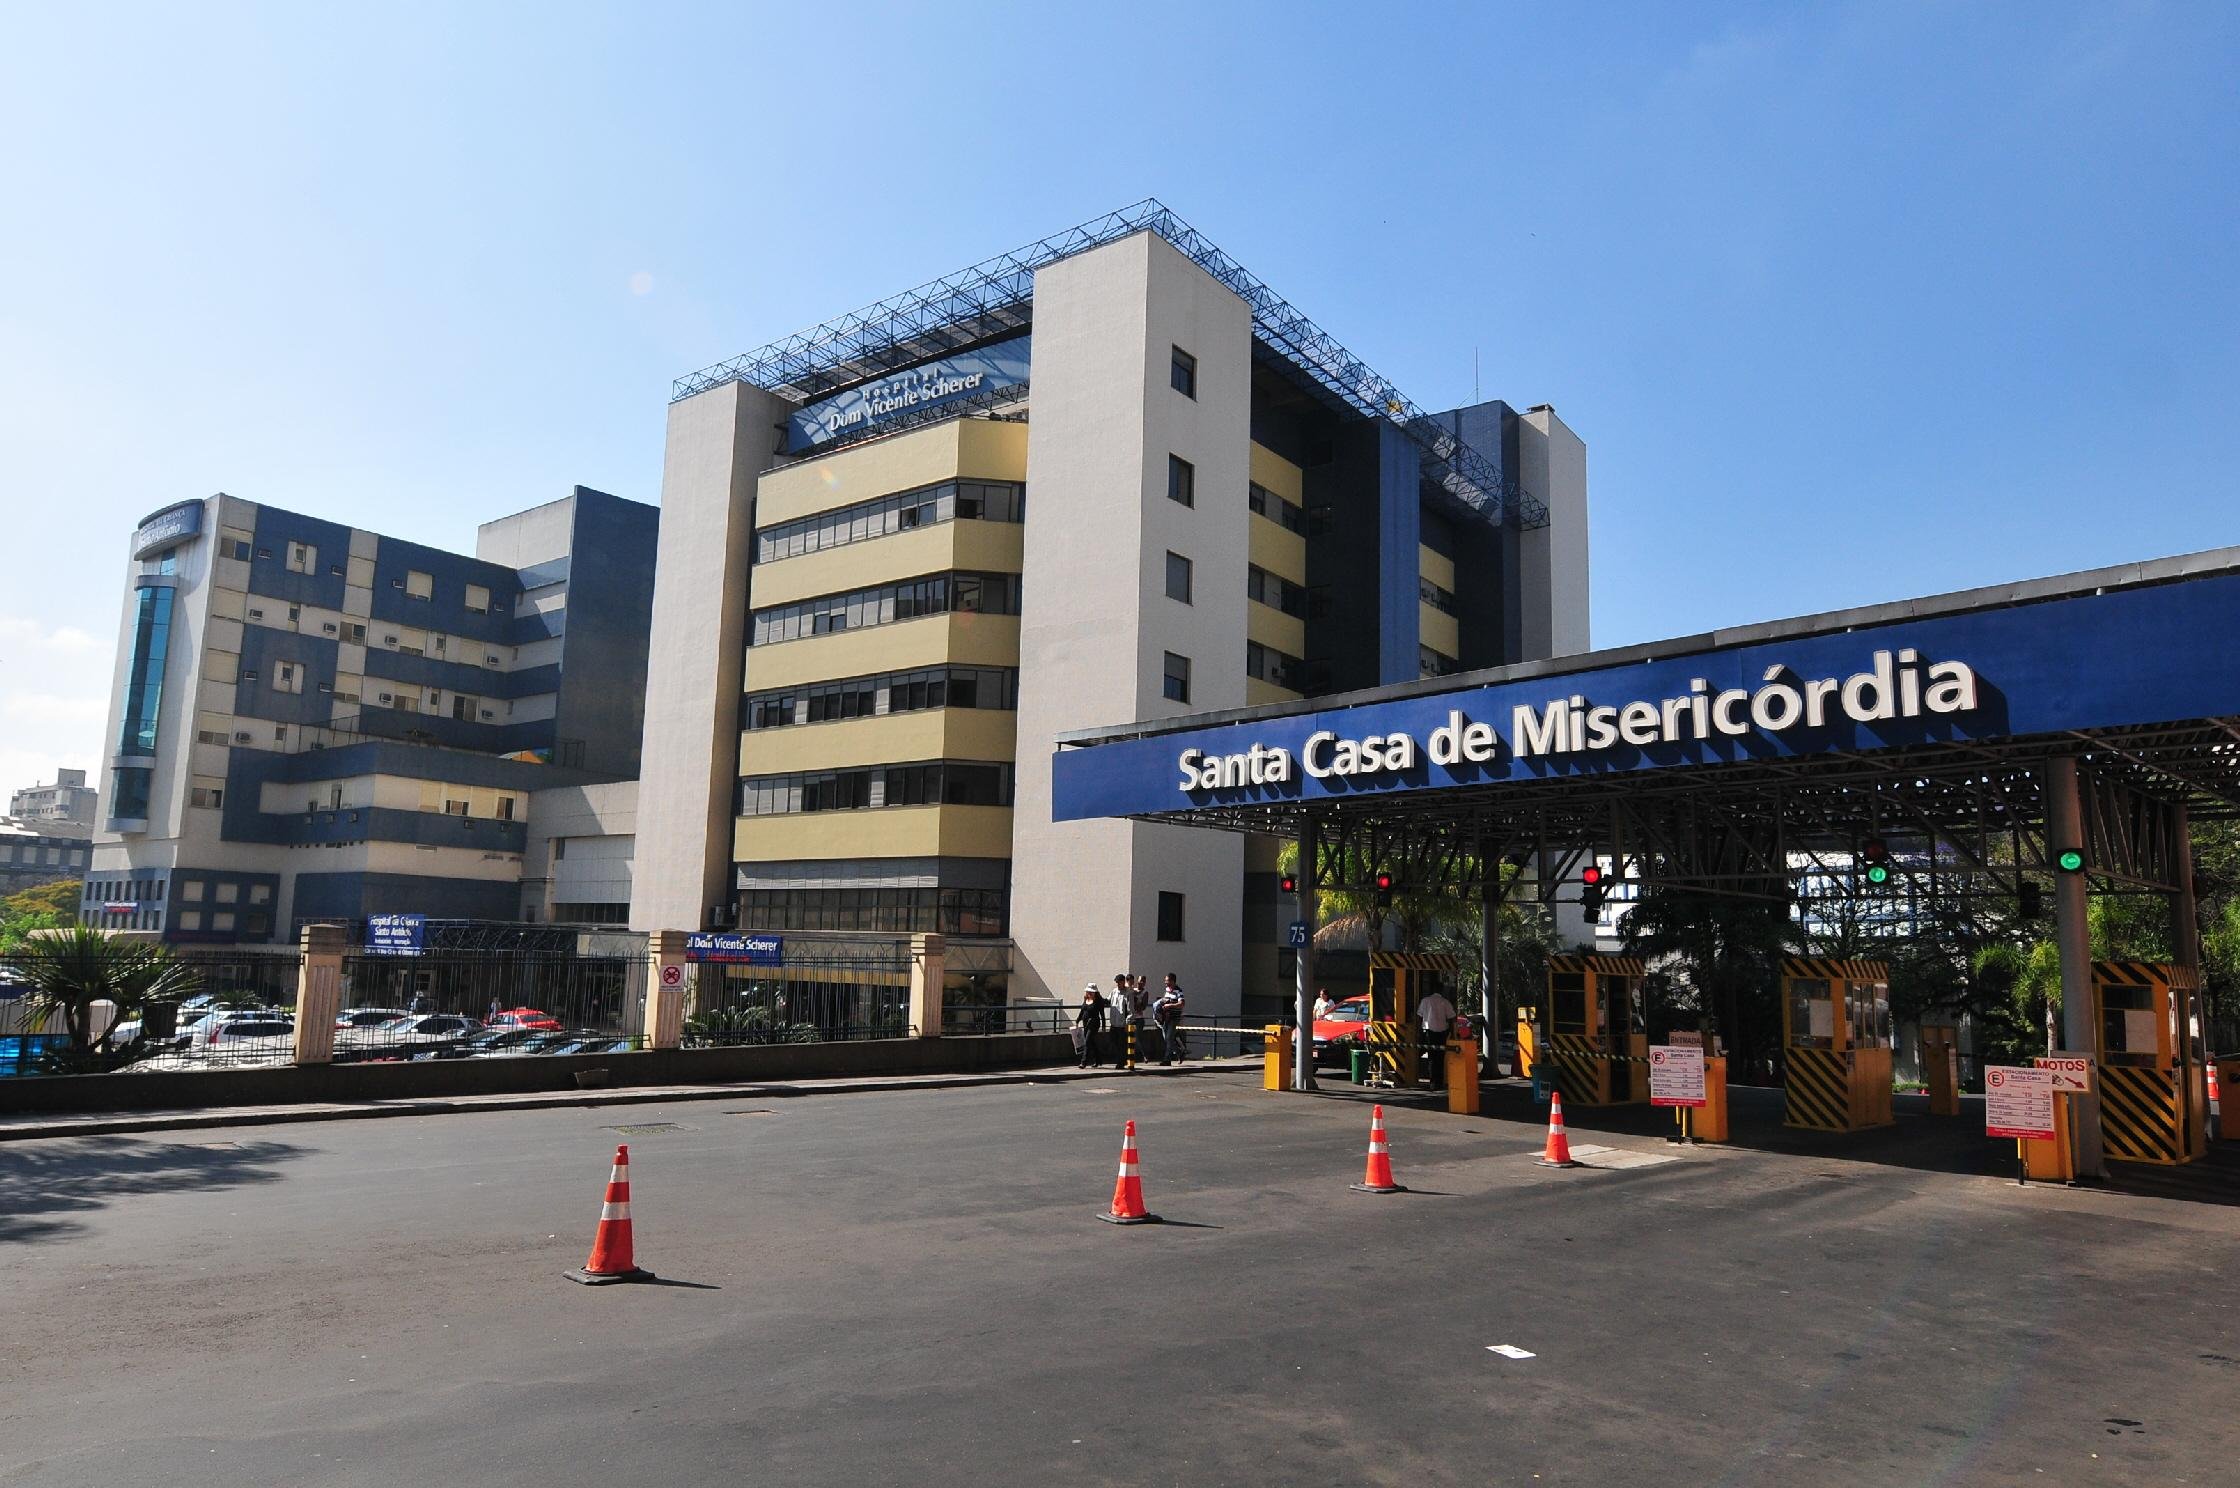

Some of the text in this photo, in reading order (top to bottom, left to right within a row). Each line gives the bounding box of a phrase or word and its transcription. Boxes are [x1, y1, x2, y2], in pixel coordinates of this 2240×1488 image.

[862, 367, 939, 400] Hospital
[830, 371, 984, 431] Dom Vicente Scherer
[1179, 647, 1978, 791] Santa Casa de Misericórdia
[1291, 926, 1305, 943] 75
[715, 938, 744, 950] Vicente
[746, 939, 777, 952] Scherer
[1670, 1036, 1701, 1045] ENTRADA
[2035, 1059, 2086, 1071] MOTOS
[2001, 1069, 2050, 1077] ESTACIONAMENTO
